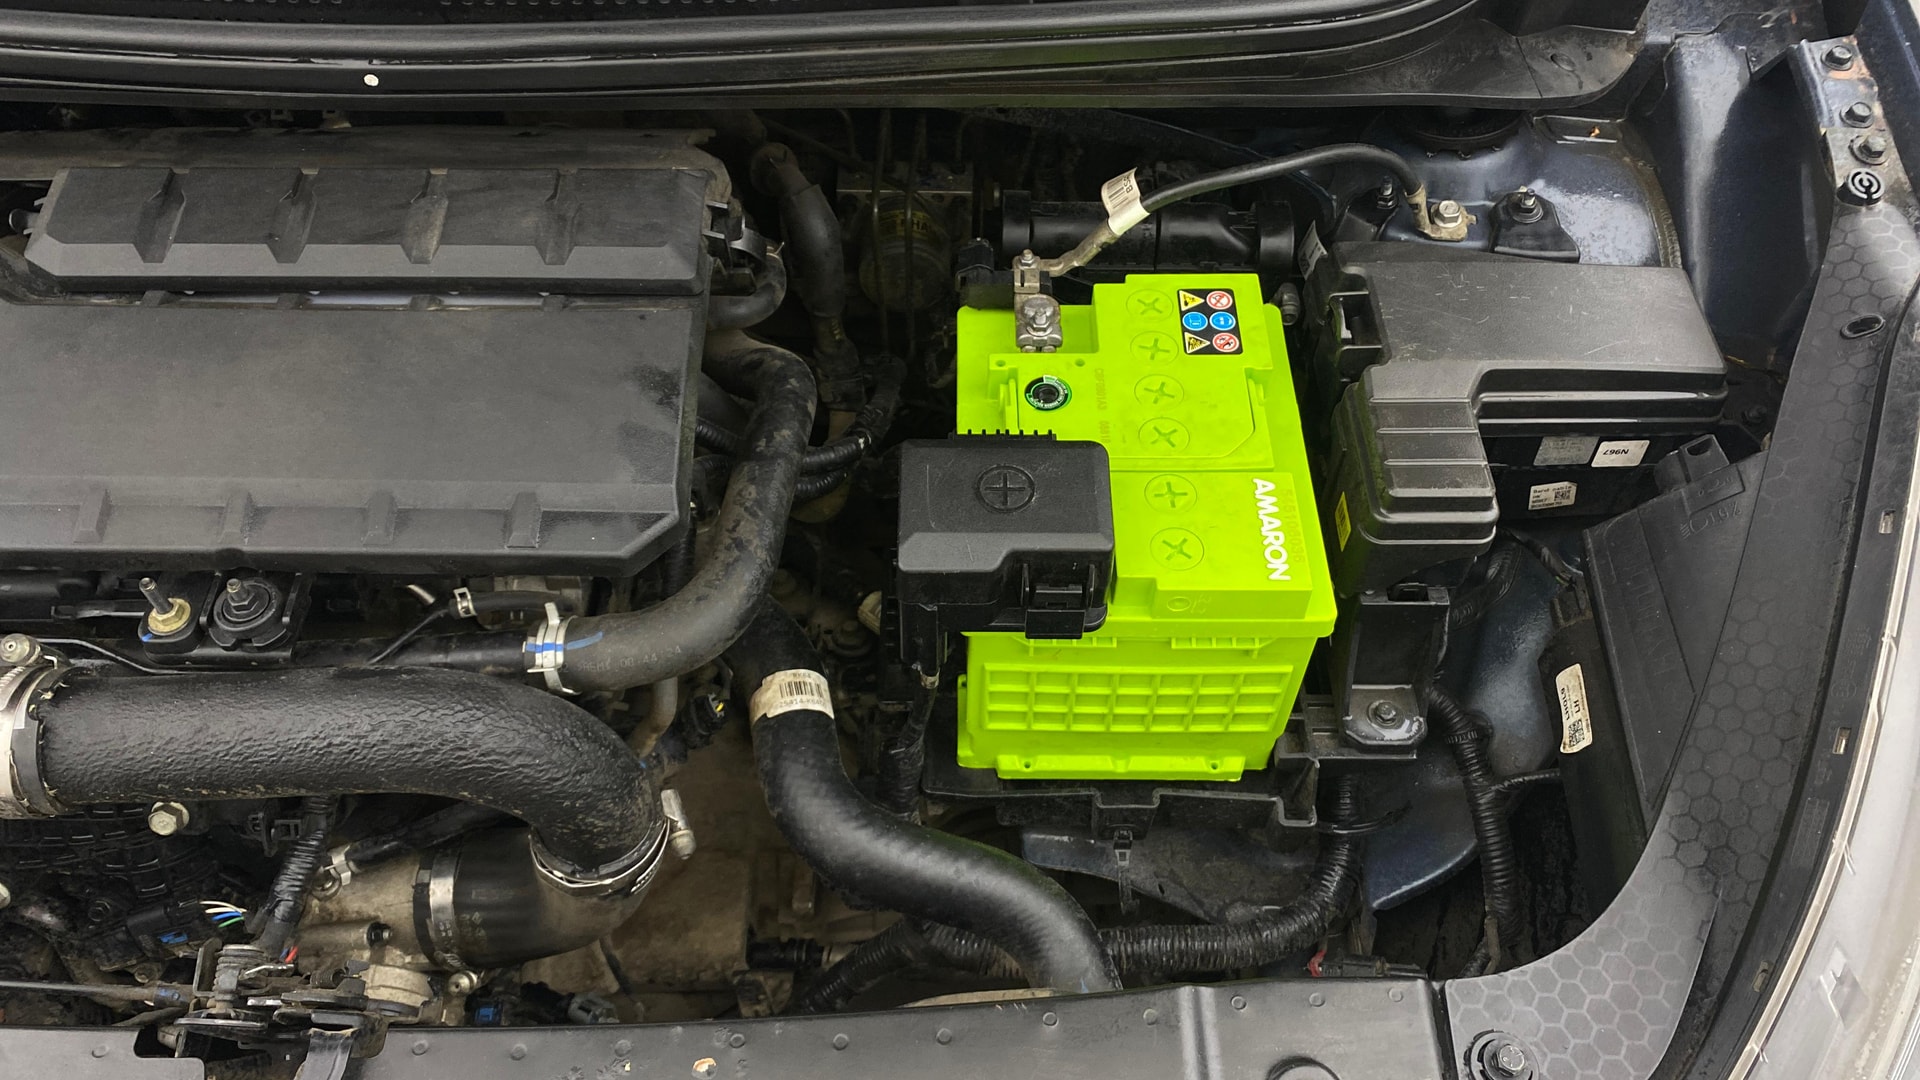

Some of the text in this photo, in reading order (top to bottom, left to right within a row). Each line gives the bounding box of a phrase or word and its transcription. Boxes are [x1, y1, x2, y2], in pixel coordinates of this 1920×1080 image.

[1602, 448, 1630, 456] N967
[1253, 478, 1291, 580] AMARON
[1573, 699, 1581, 714] LH
